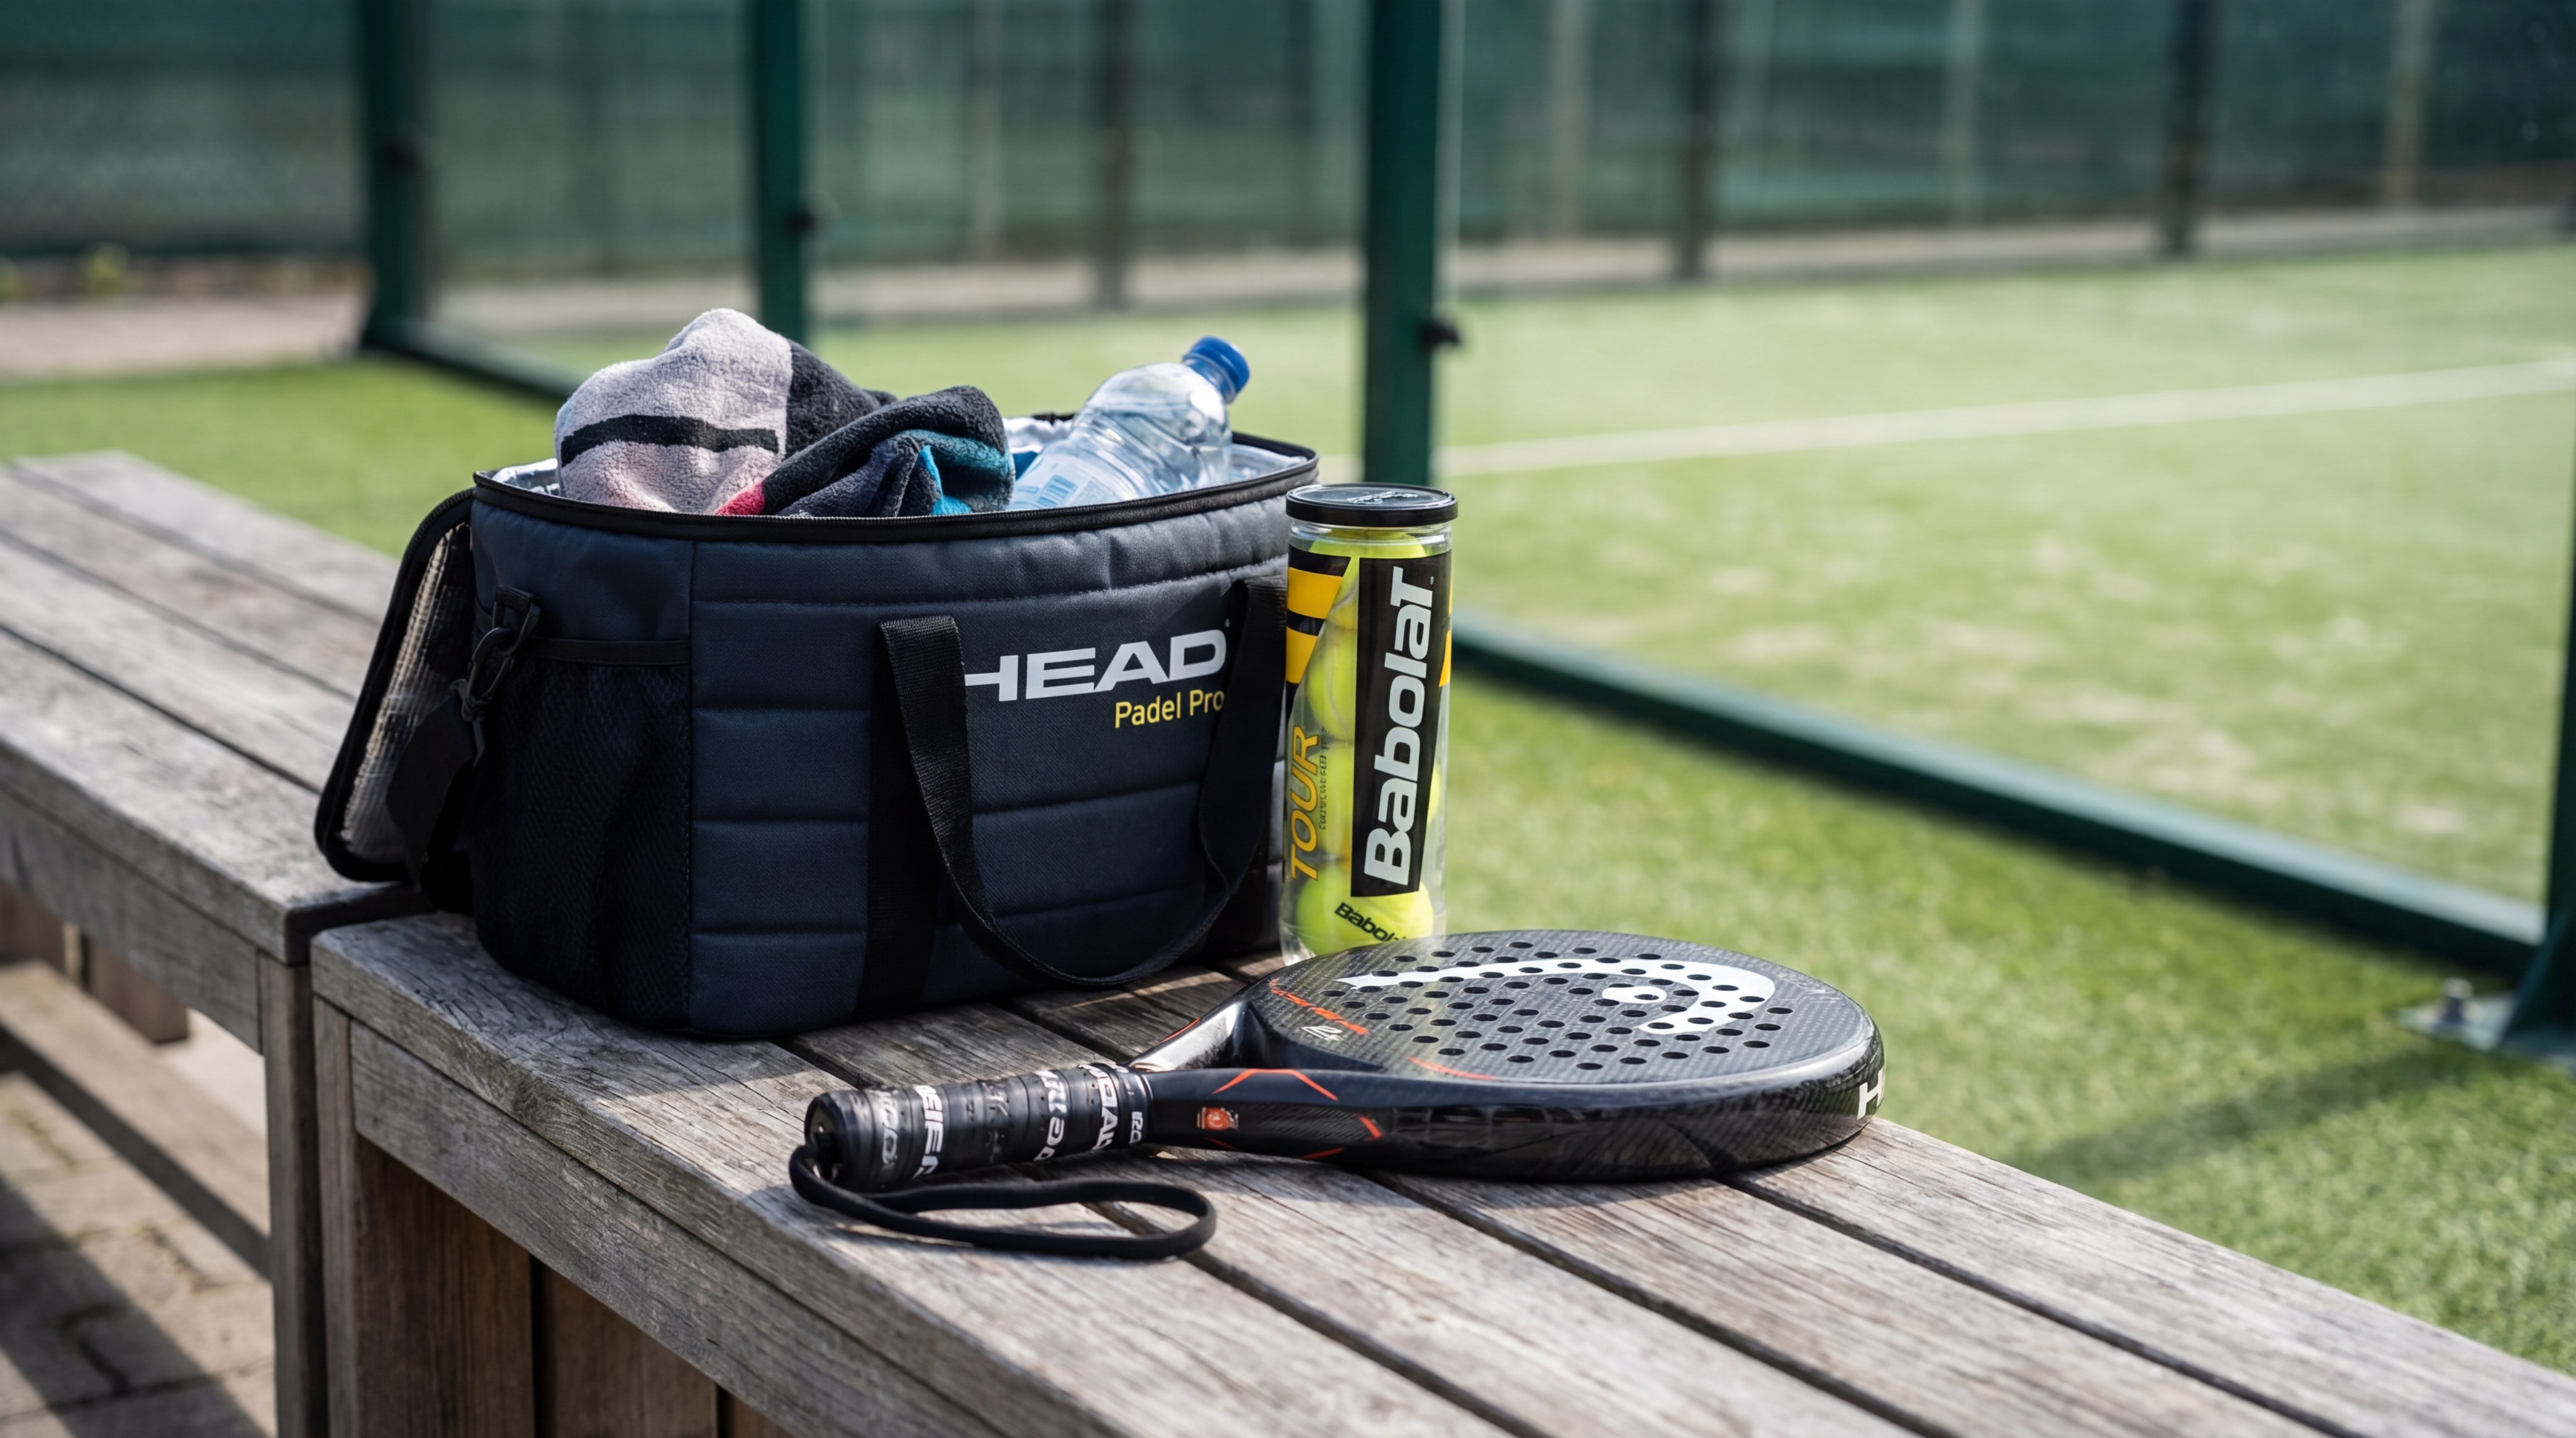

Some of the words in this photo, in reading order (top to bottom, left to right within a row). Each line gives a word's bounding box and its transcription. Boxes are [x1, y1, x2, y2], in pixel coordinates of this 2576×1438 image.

[964, 629, 1226, 702] HEAD
[1114, 691, 1182, 728] Padel
[1189, 689, 1224, 715] Pro
[1291, 725, 1319, 881] TOUR
[1334, 901, 1407, 942] Babol
